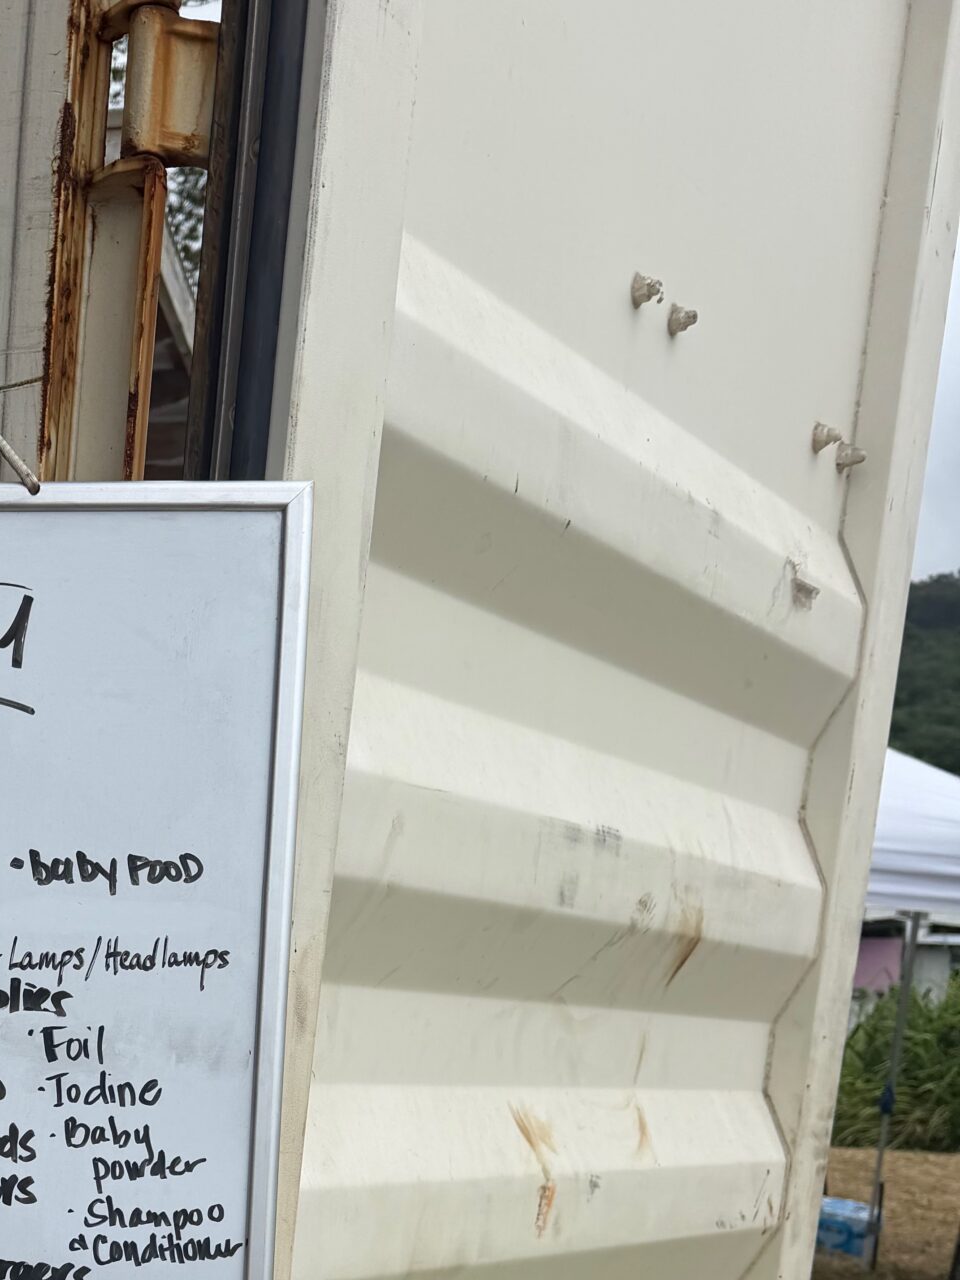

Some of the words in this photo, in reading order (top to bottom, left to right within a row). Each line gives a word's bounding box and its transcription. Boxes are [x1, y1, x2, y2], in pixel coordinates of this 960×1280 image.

[40, 1025, 105, 1065] Foil
[45, 1070, 162, 1107] Iodine
[64, 1115, 155, 1163] Baby
